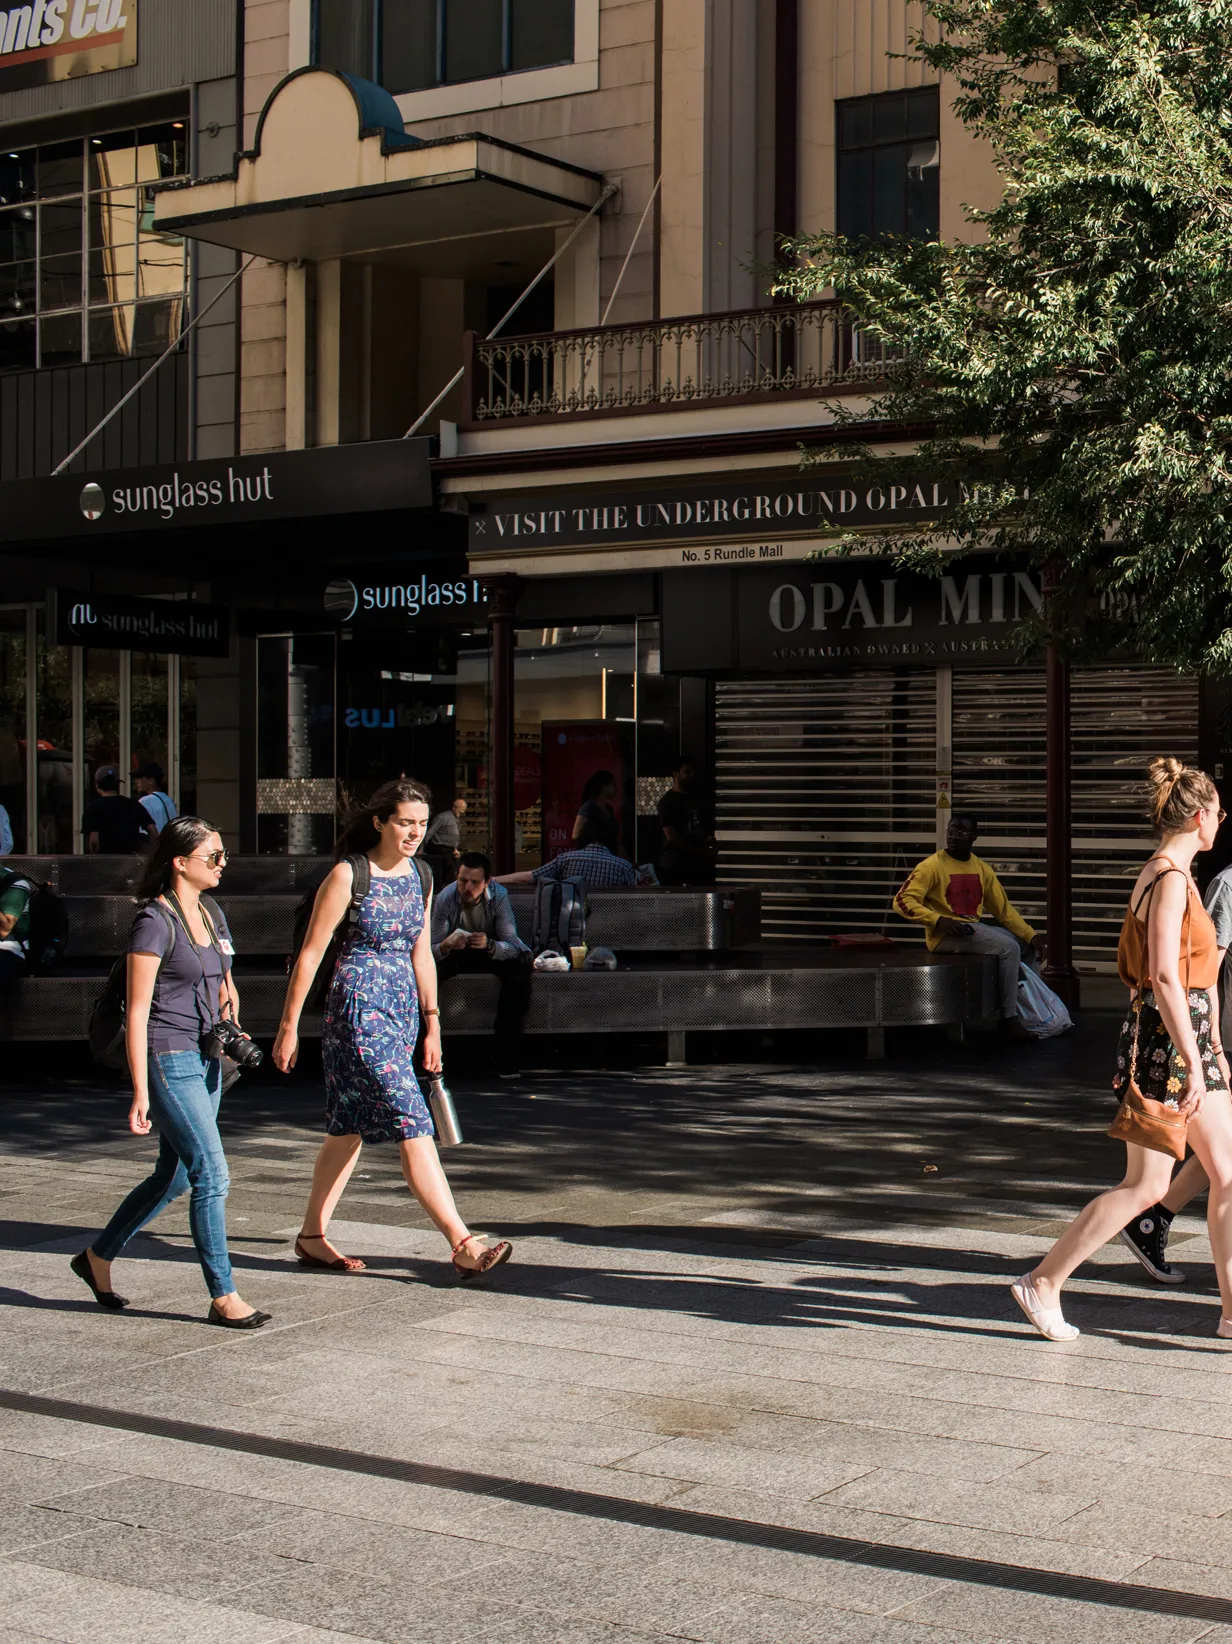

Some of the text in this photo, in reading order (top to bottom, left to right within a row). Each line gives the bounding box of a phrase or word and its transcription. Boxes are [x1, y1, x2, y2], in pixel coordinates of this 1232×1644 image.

[0, 0, 68, 54] nts
[113, 467, 274, 519] sunglass hut
[494, 510, 566, 537] VISIT
[572, 505, 628, 532] THE
[634, 489, 857, 528] UNDERGROUND
[866, 482, 948, 511] OPAL
[682, 545, 783, 562] No. 5 Rundle Mall
[362, 574, 467, 616] sunglass
[768, 578, 913, 633] OPAL
[101, 611, 186, 641] sunglass
[771, 645, 861, 659] AUSTRALIAN
[867, 642, 920, 656] OWNED
